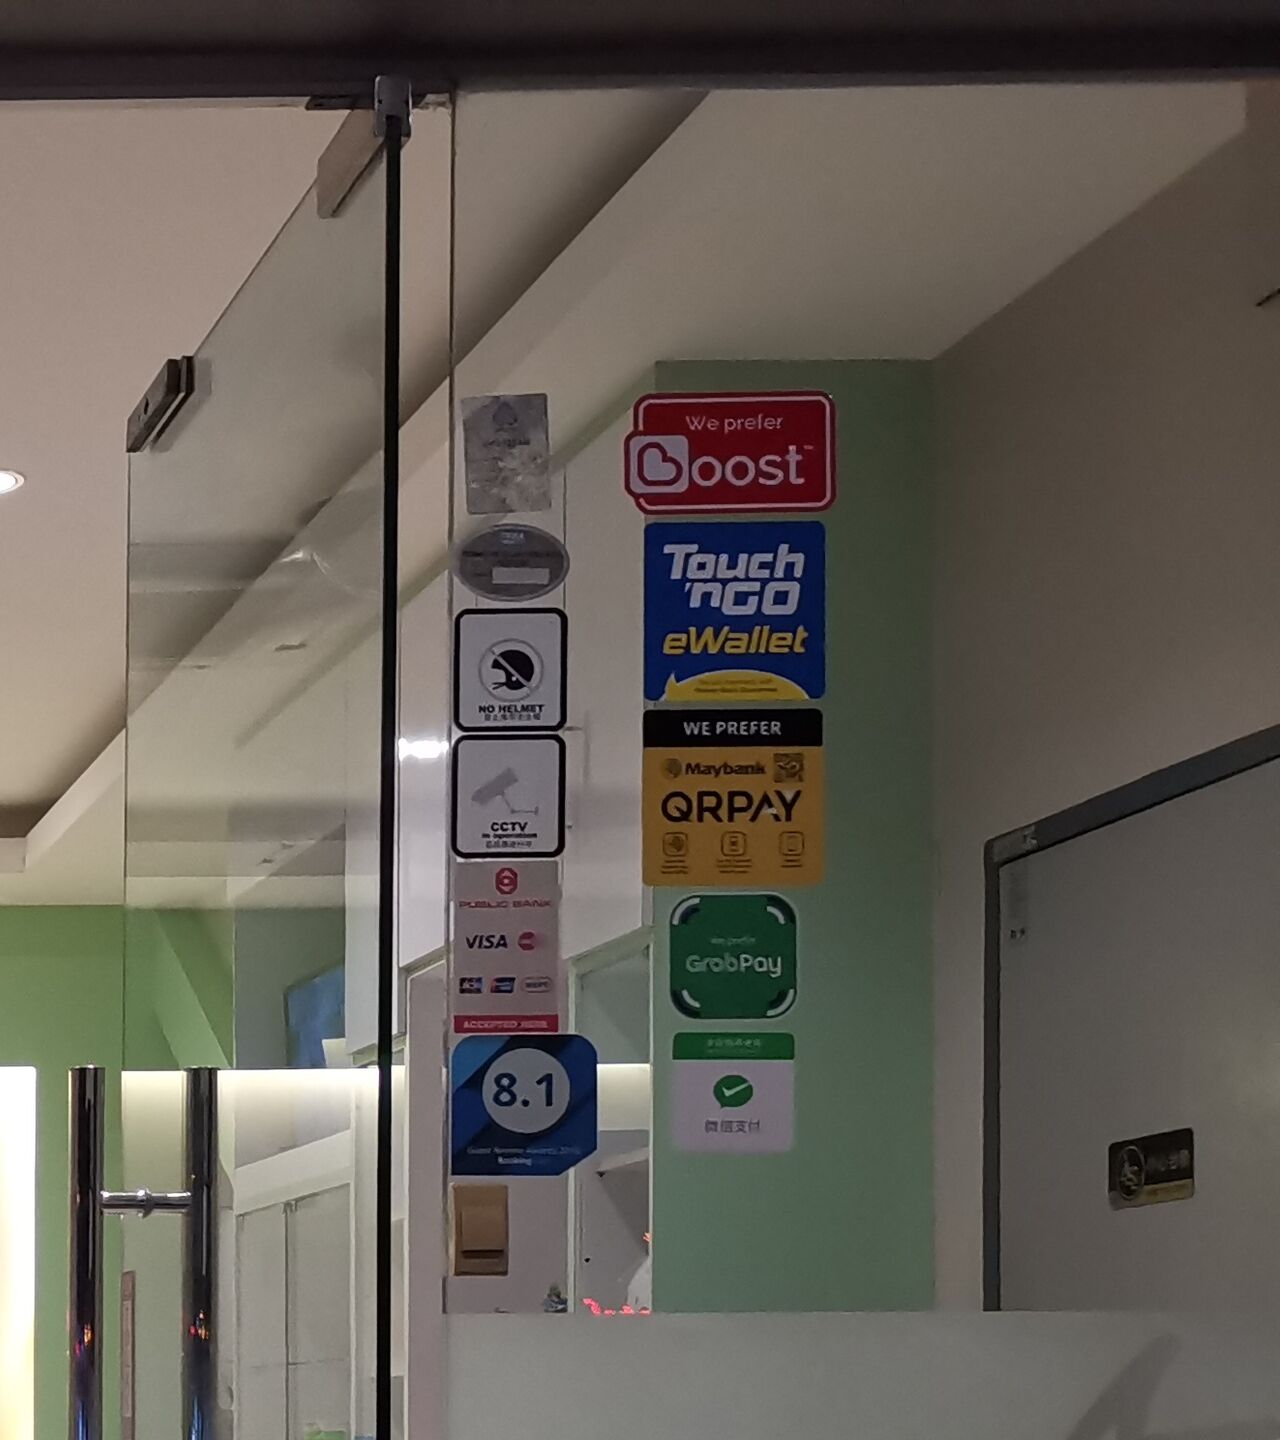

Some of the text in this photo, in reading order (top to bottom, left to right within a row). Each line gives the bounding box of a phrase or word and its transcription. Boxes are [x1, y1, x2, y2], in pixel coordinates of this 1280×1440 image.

[686, 414, 784, 435] We prefer
[663, 543, 806, 581] Touch
[662, 625, 809, 654] eWallet
[478, 704, 546, 713] NO HELMET
[683, 721, 782, 736] WE PREFER
[685, 761, 767, 779] Maybank
[660, 790, 803, 824] QRPAY
[490, 821, 528, 833] CCTV
[465, 934, 508, 949] VISA
[685, 952, 782, 978] GrabPay
[492, 1072, 555, 1108] 8.1
